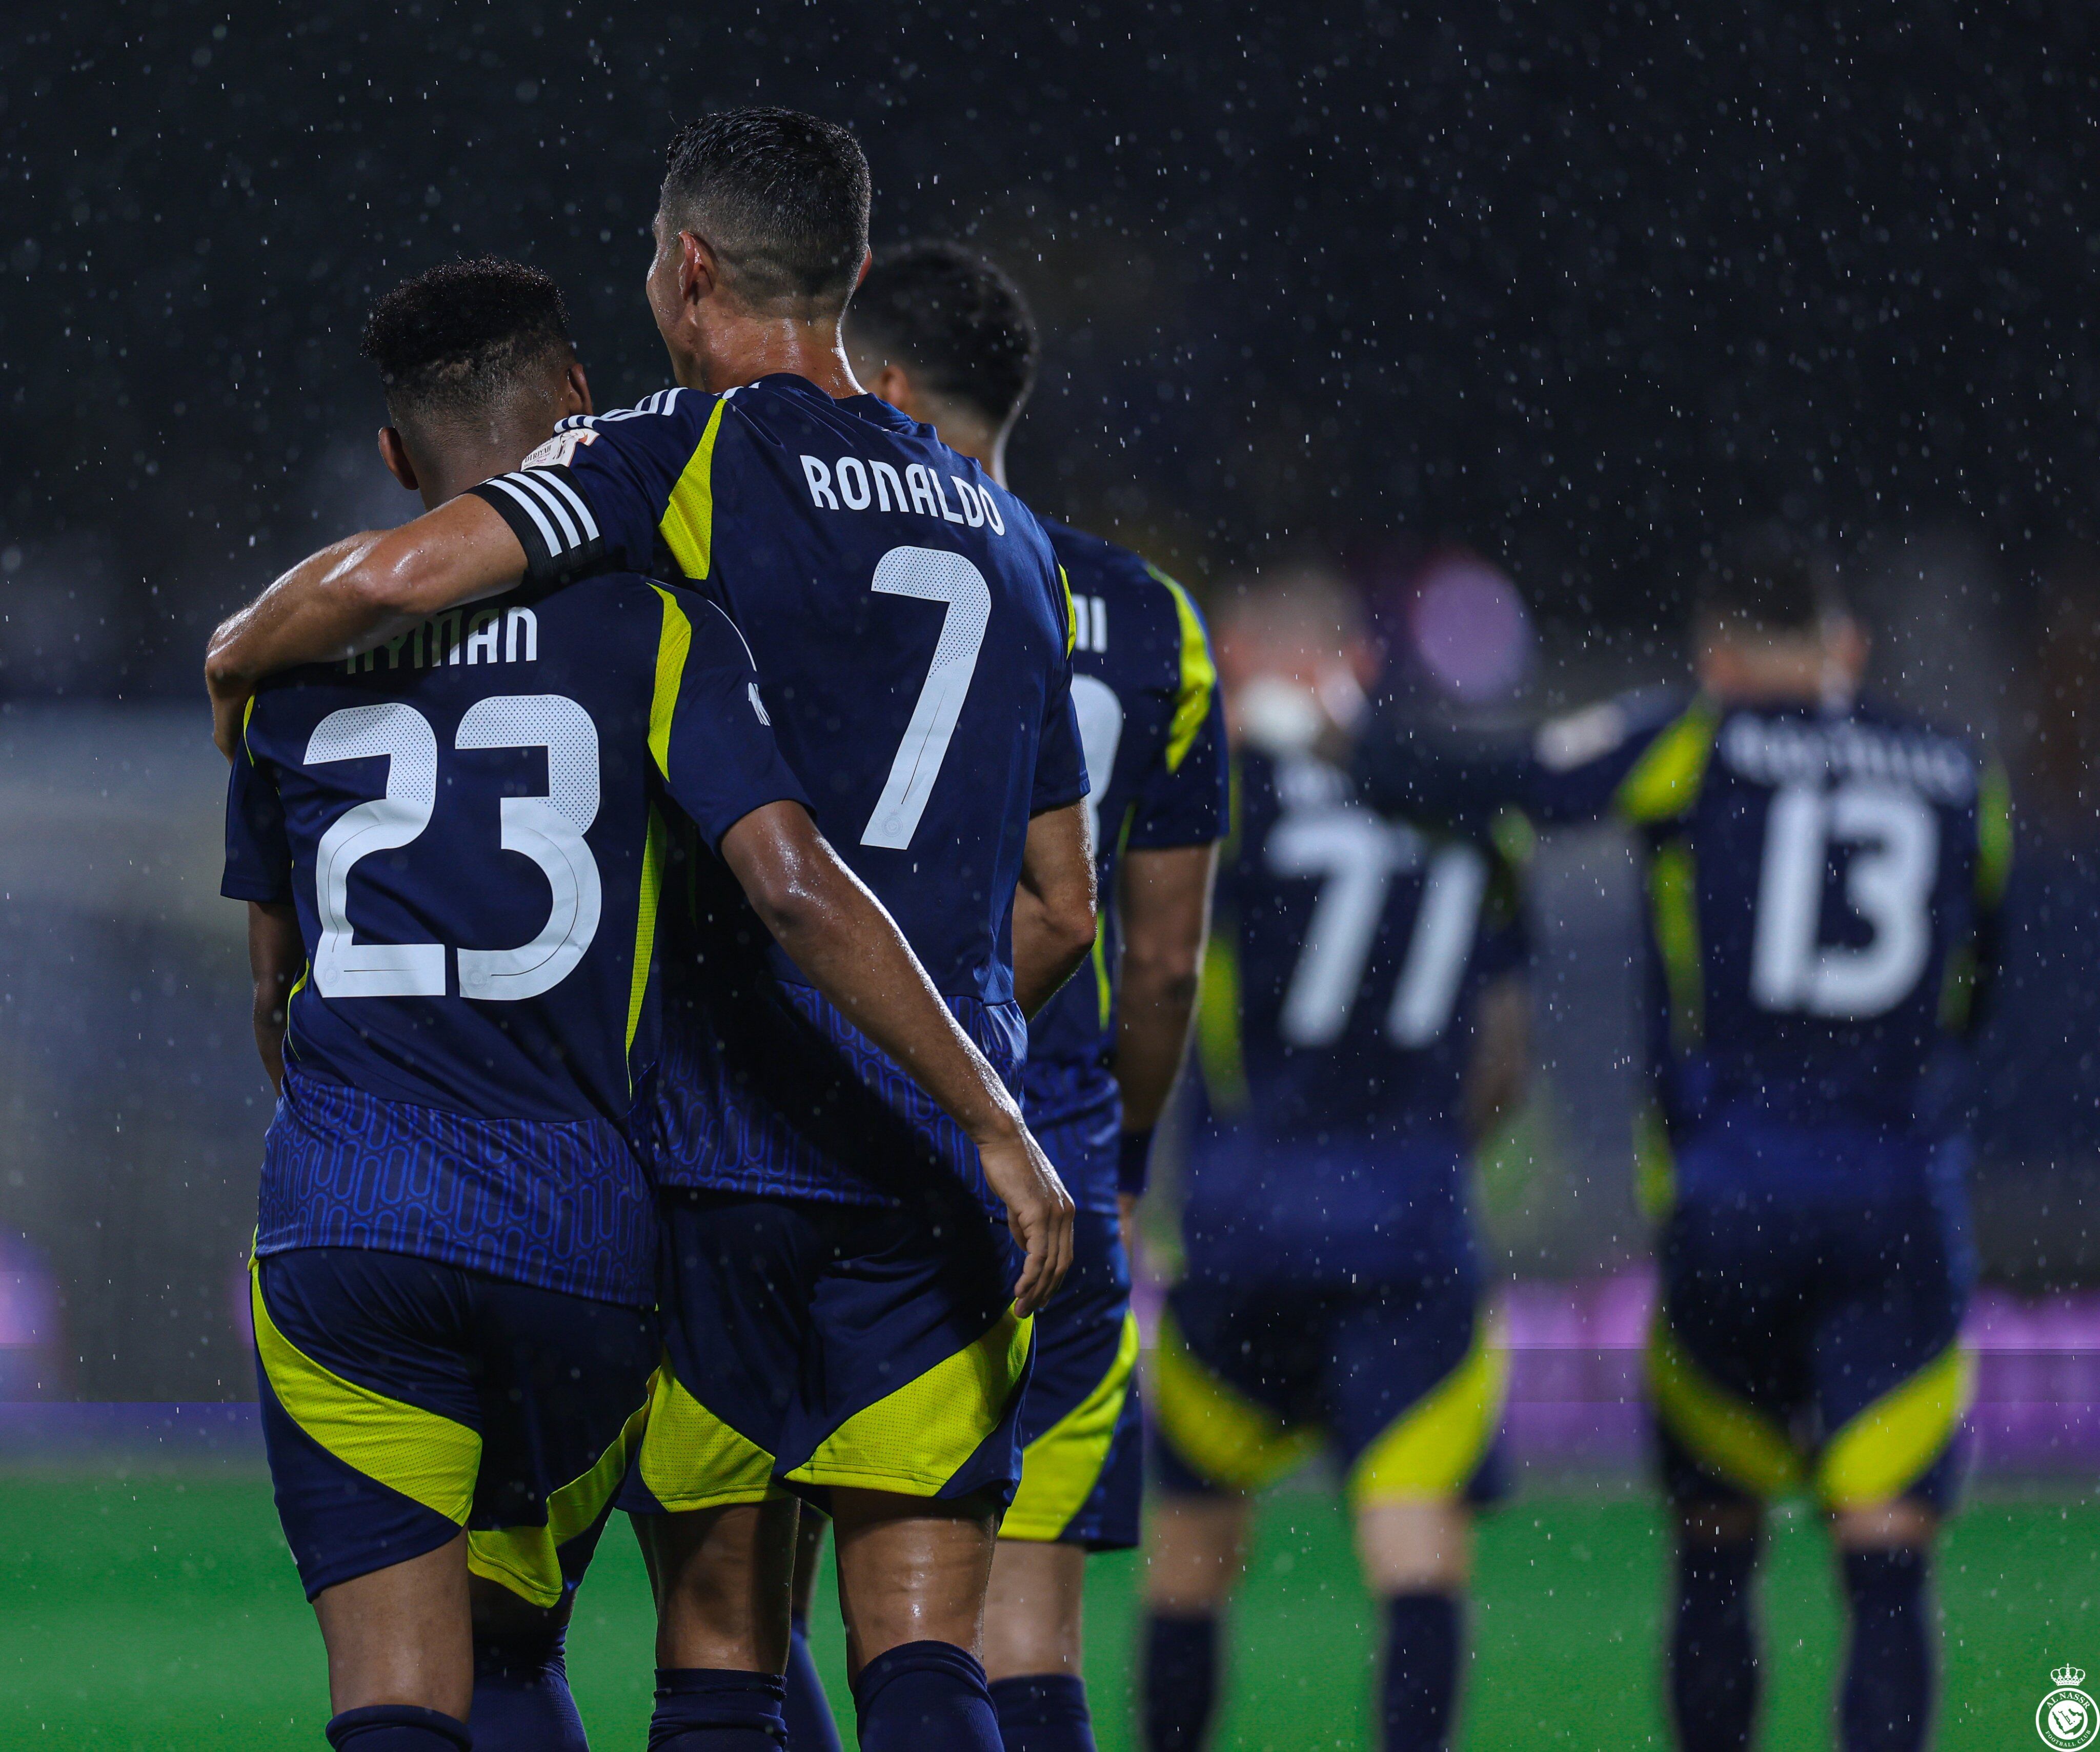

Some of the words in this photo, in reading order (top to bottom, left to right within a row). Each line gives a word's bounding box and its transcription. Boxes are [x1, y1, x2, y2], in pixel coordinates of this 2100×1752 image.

[799, 454, 1005, 536] RONALDO
[859, 545, 992, 851] 7
[303, 694, 602, 1001] 23
[1264, 811, 1484, 1046] 77
[1749, 784, 1942, 1017] 13
